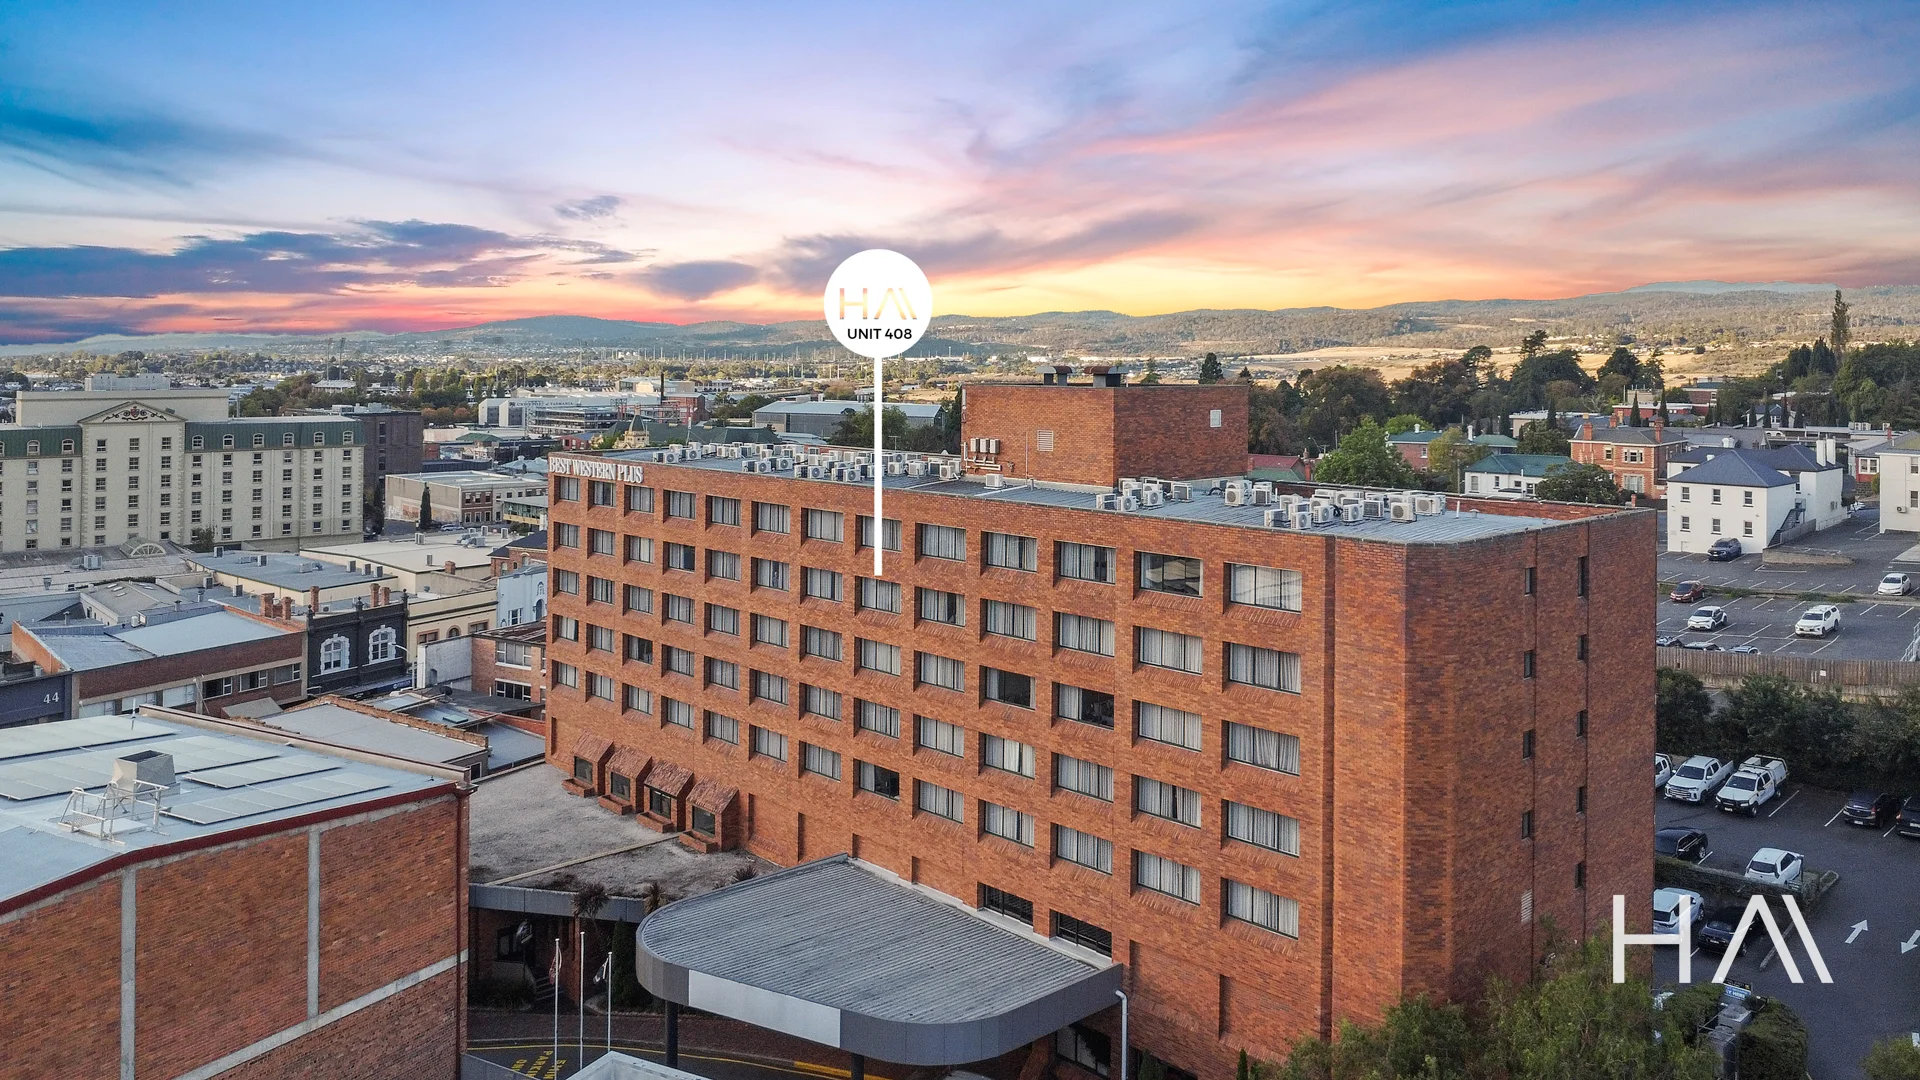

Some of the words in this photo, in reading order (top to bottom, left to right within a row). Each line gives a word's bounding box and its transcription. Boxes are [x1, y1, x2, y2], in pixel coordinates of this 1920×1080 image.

[549, 456, 572, 475] BEST
[572, 460, 616, 480] WESTERN
[617, 464, 644, 483] PLUS
[43, 691, 60, 704] 44
[525, 1051, 554, 1076] PARKI
